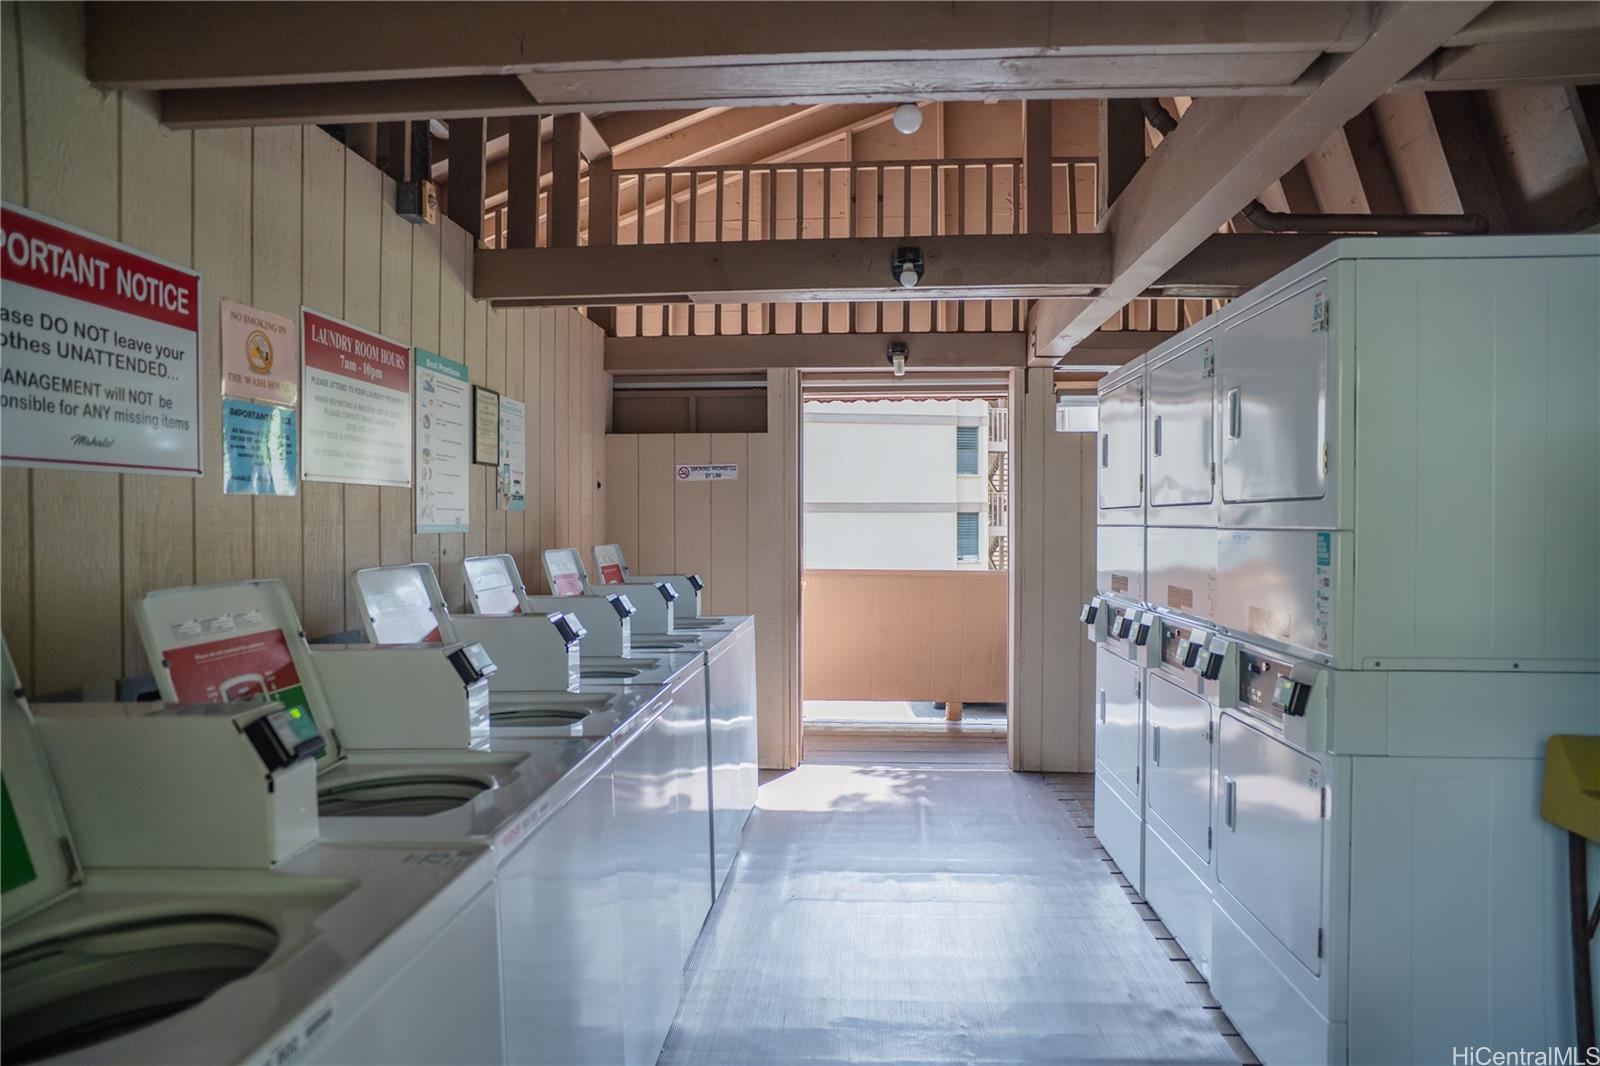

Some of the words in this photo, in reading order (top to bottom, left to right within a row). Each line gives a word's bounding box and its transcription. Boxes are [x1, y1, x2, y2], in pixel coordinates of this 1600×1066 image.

[116, 267, 190, 315] NOTICE
[40, 313, 68, 335] DO
[73, 321, 110, 344] NOT
[113, 331, 152, 354] leave
[155, 344, 186, 362] your
[230, 310, 242, 322] NO
[243, 314, 278, 332] SMOKING
[56, 341, 180, 382] UNATTENDED...
[311, 324, 353, 353] LAUNDRY
[354, 339, 379, 362] ROOM
[381, 350, 406, 371] HOURS
[339, 354, 357, 371] 7am
[363, 363, 383, 380] 10pm
[0, 367, 102, 399] ANAGEMENT
[104, 386, 126, 401] will
[128, 389, 154, 408] NOT
[158, 393, 173, 410] be
[228, 372, 242, 384] THE
[244, 375, 267, 389] WASH
[267, 381, 289, 392] HOU
[59, 401, 79, 416] for
[83, 403, 111, 420] ANY
[114, 409, 160, 430] missing
[161, 414, 190, 431] items
